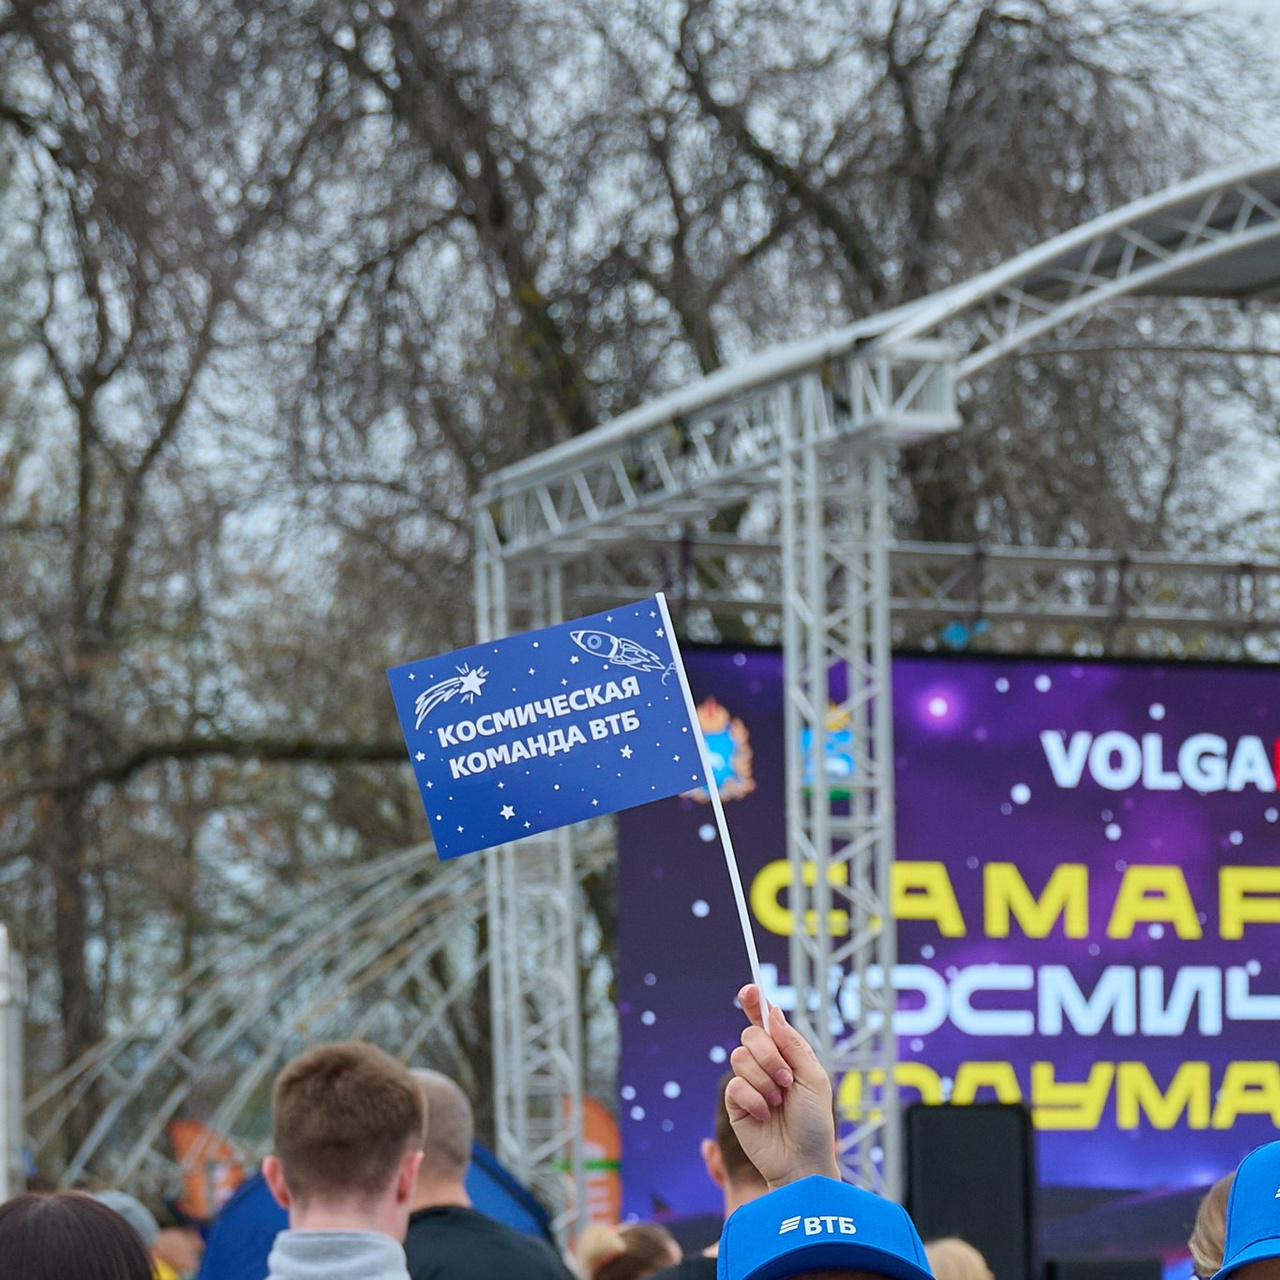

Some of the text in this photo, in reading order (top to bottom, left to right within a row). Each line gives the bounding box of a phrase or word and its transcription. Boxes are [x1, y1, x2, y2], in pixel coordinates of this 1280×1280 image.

[437, 676, 641, 748] КОСМИЧЕСКАЯ
[449, 710, 641, 779] КОМАНДА ВТБ
[803, 1216, 857, 1235] ВТБ
